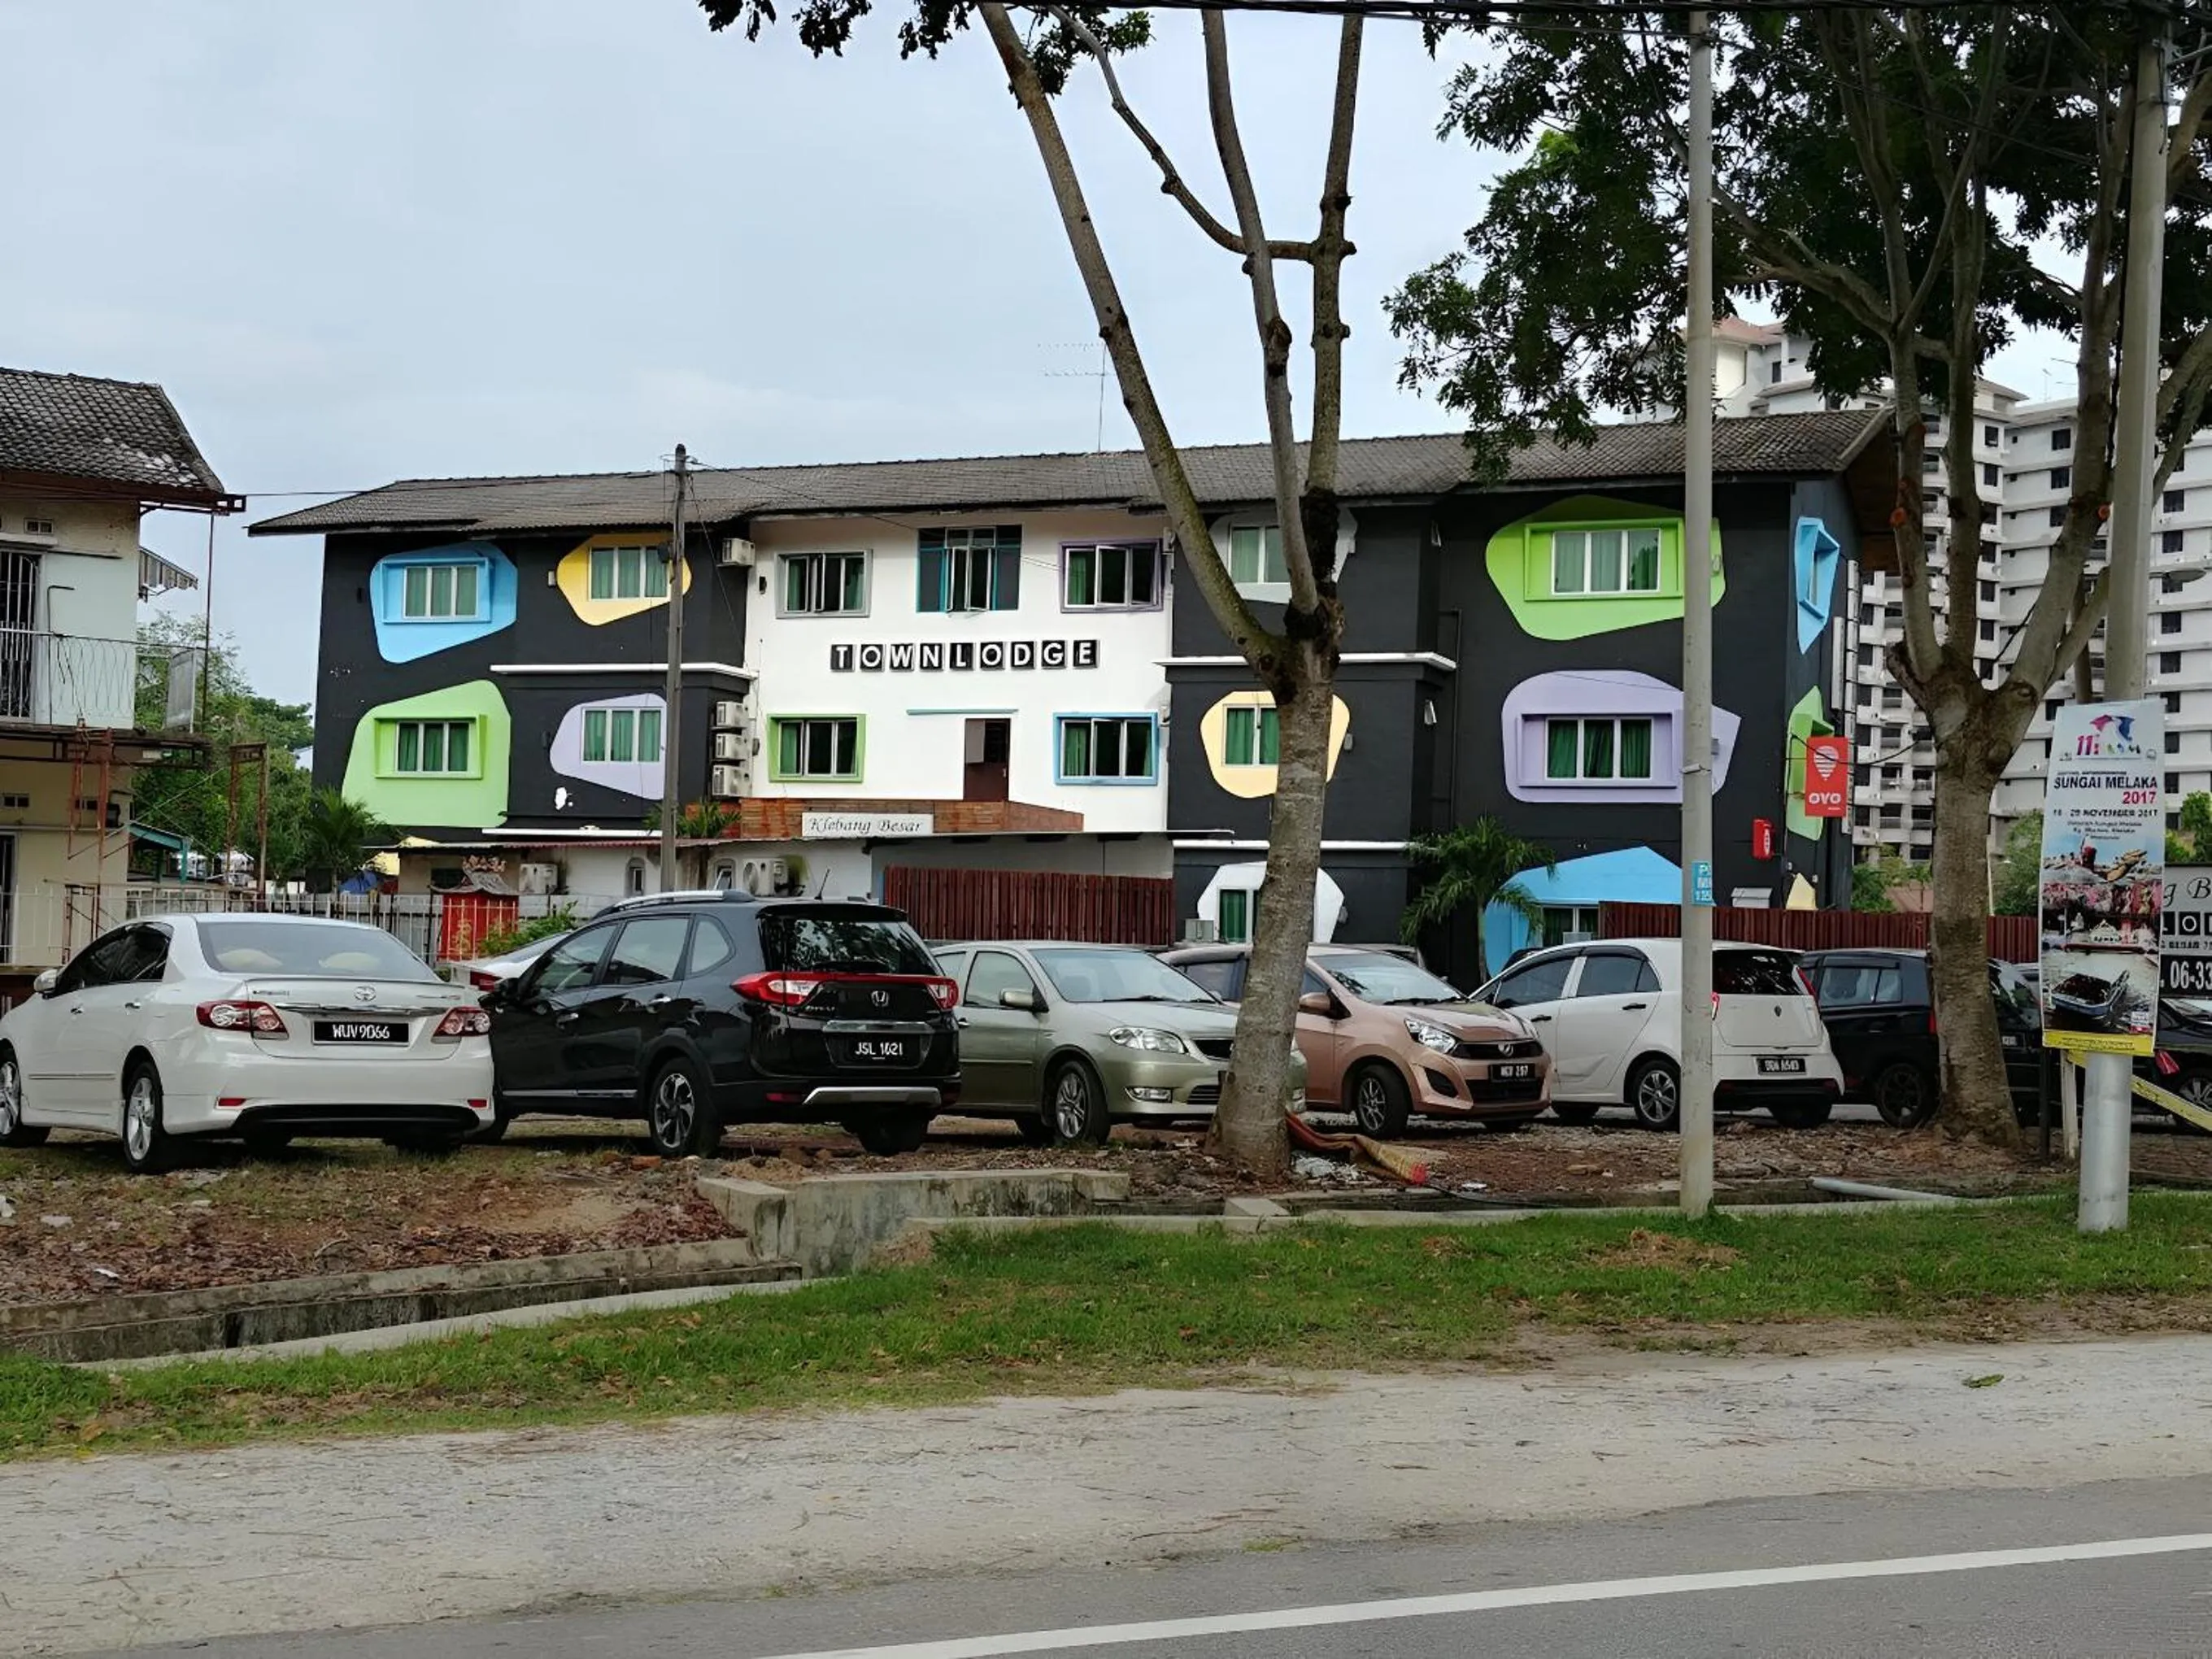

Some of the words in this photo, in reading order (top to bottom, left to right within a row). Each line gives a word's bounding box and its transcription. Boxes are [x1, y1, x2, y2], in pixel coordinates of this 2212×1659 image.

[834, 641, 1095, 669] TOWNLODGE
[2053, 777, 2101, 789] SUNGAI
[2105, 777, 2158, 789] MELAKA
[2122, 791, 2157, 804] 2017
[809, 816, 871, 834] Klebang
[878, 819, 924, 833] Besar
[332, 1024, 358, 1039] WUV
[855, 1042, 876, 1056] JSL
